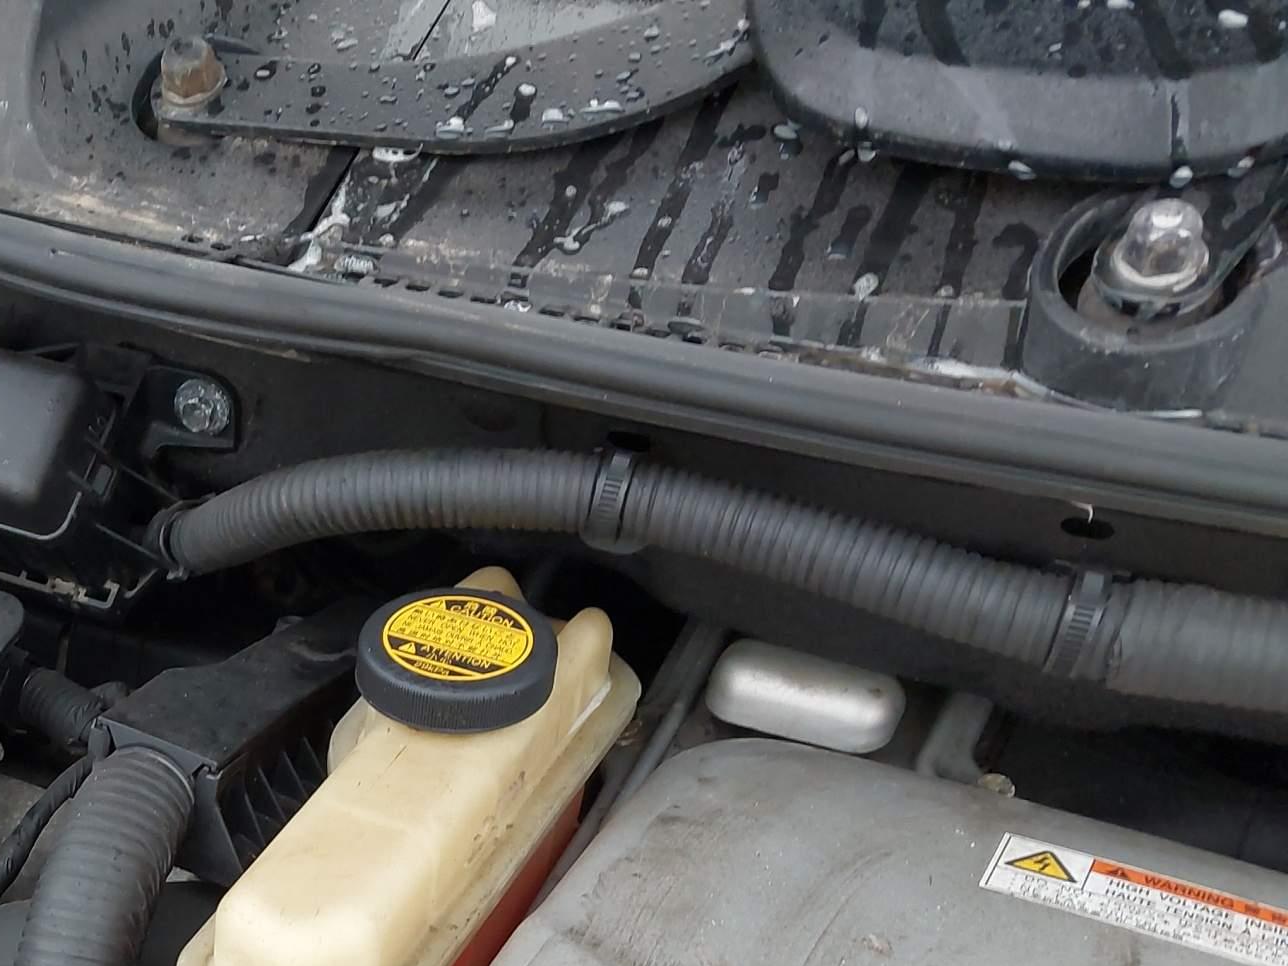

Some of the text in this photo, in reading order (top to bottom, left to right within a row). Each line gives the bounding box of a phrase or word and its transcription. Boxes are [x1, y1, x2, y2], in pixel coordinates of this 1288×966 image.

[450, 604, 514, 628] CAUTION
[420, 644, 491, 669] ATTENTION
[1105, 888, 1155, 906] HAUTE
[1162, 905, 1232, 930] TENSION
[1108, 879, 1151, 896] HIGH
[1159, 892, 1231, 919] VOLTAGE
[1144, 875, 1234, 909] WARNING
